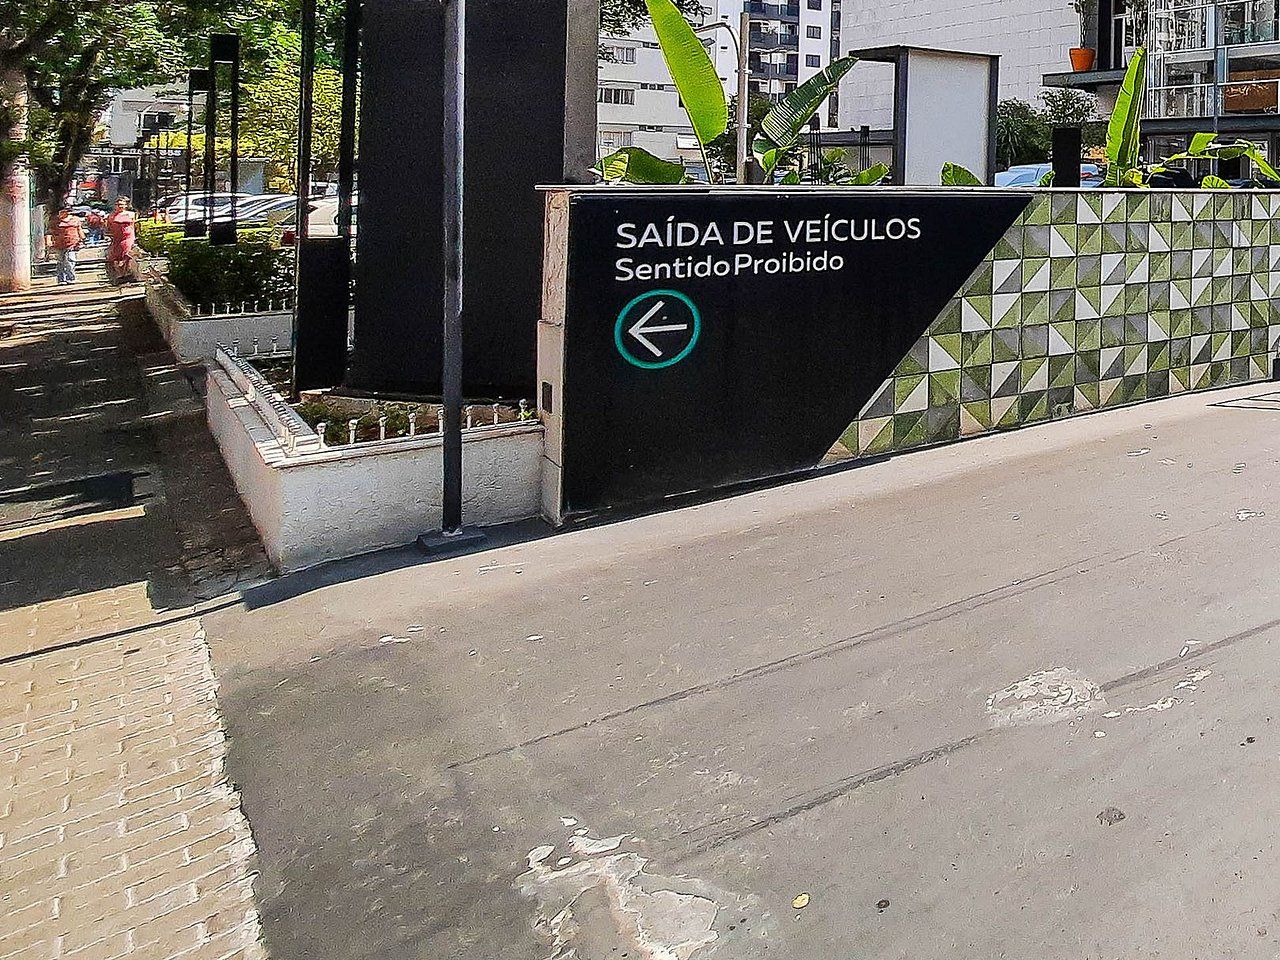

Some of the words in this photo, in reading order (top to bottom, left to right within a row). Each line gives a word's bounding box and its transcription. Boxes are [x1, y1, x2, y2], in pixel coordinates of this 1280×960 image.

[615, 215, 724, 249] SAÍDA
[732, 220, 773, 245] DE
[783, 213, 921, 243] VEÍCULOS
[615, 253, 730, 282] Sentido
[734, 250, 844, 276] Proibido
